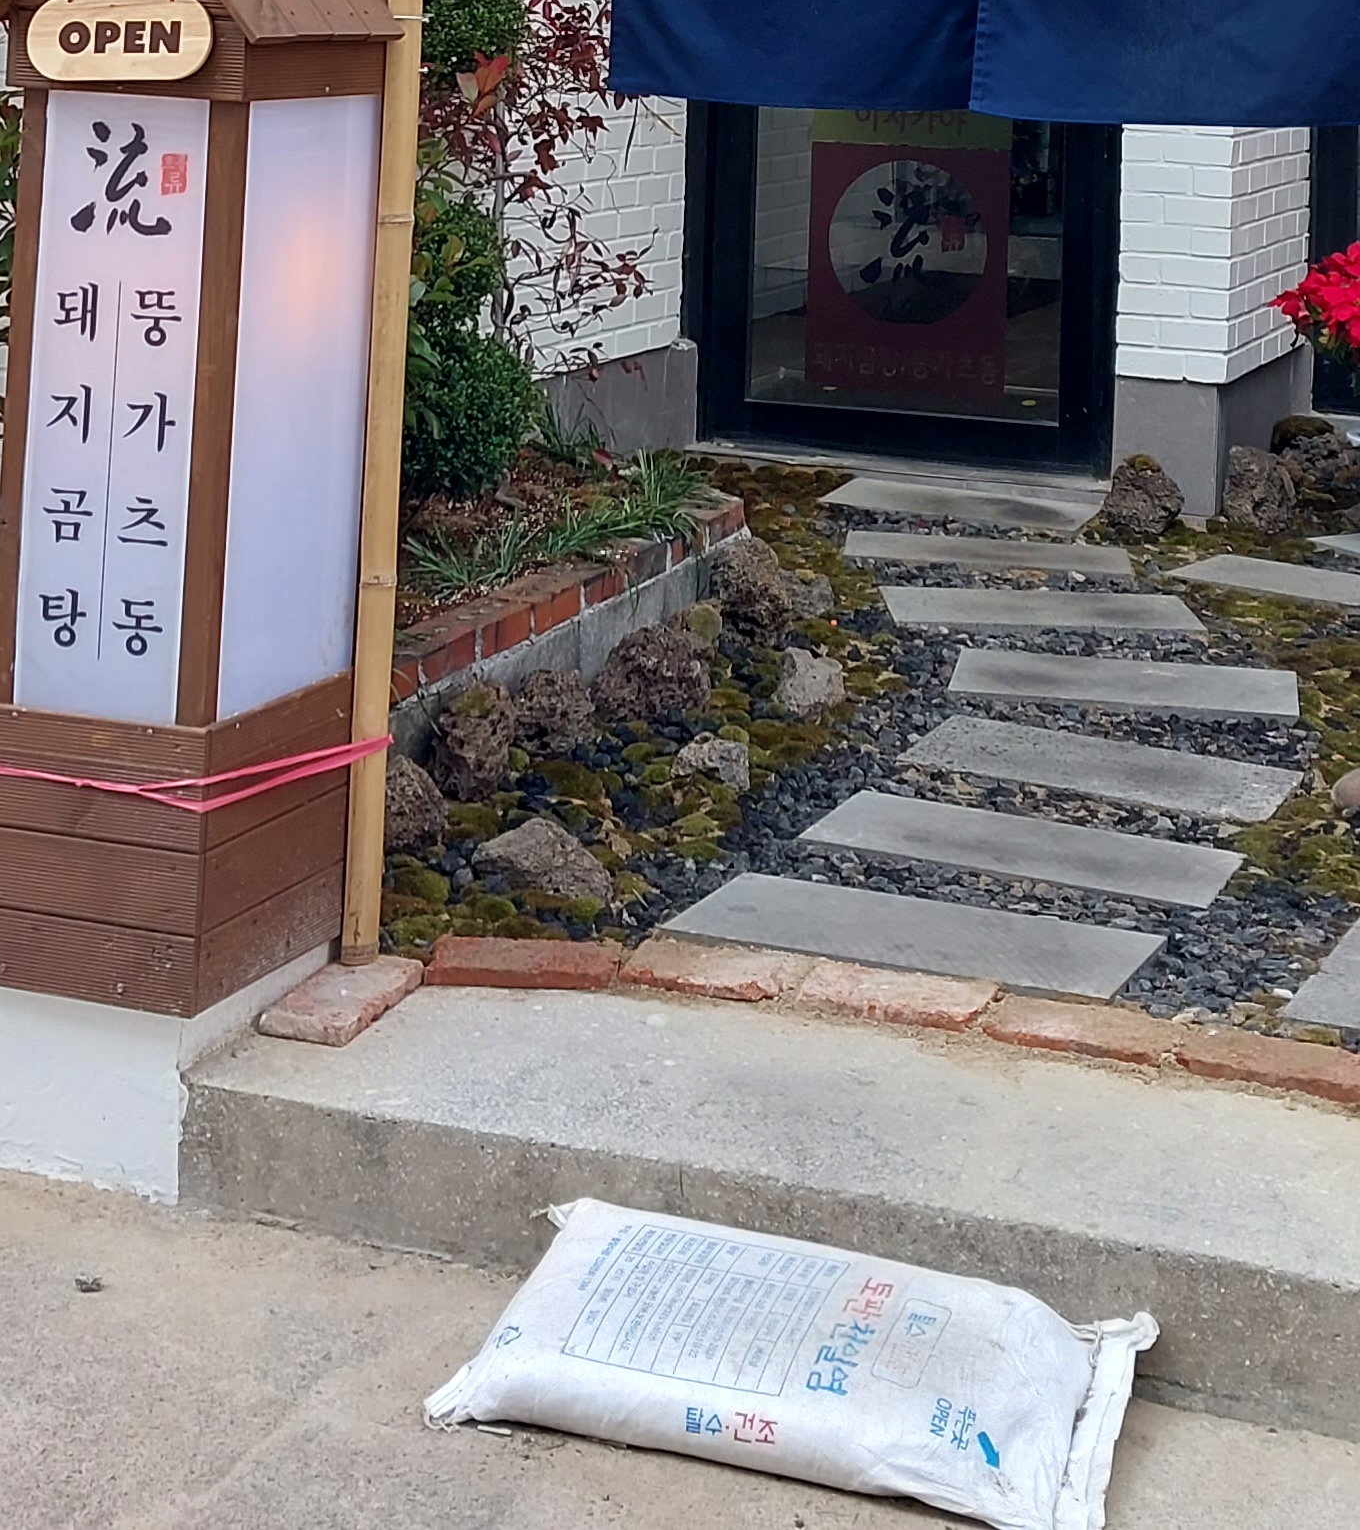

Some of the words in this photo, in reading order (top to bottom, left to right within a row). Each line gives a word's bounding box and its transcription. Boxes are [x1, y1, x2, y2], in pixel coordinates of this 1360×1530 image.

[58, 20, 182, 55] OPEN
[38, 282, 99, 648] 돼지곰탕
[112, 289, 184, 658] 뚱가츠동
[929, 1397, 953, 1438] OPEN
